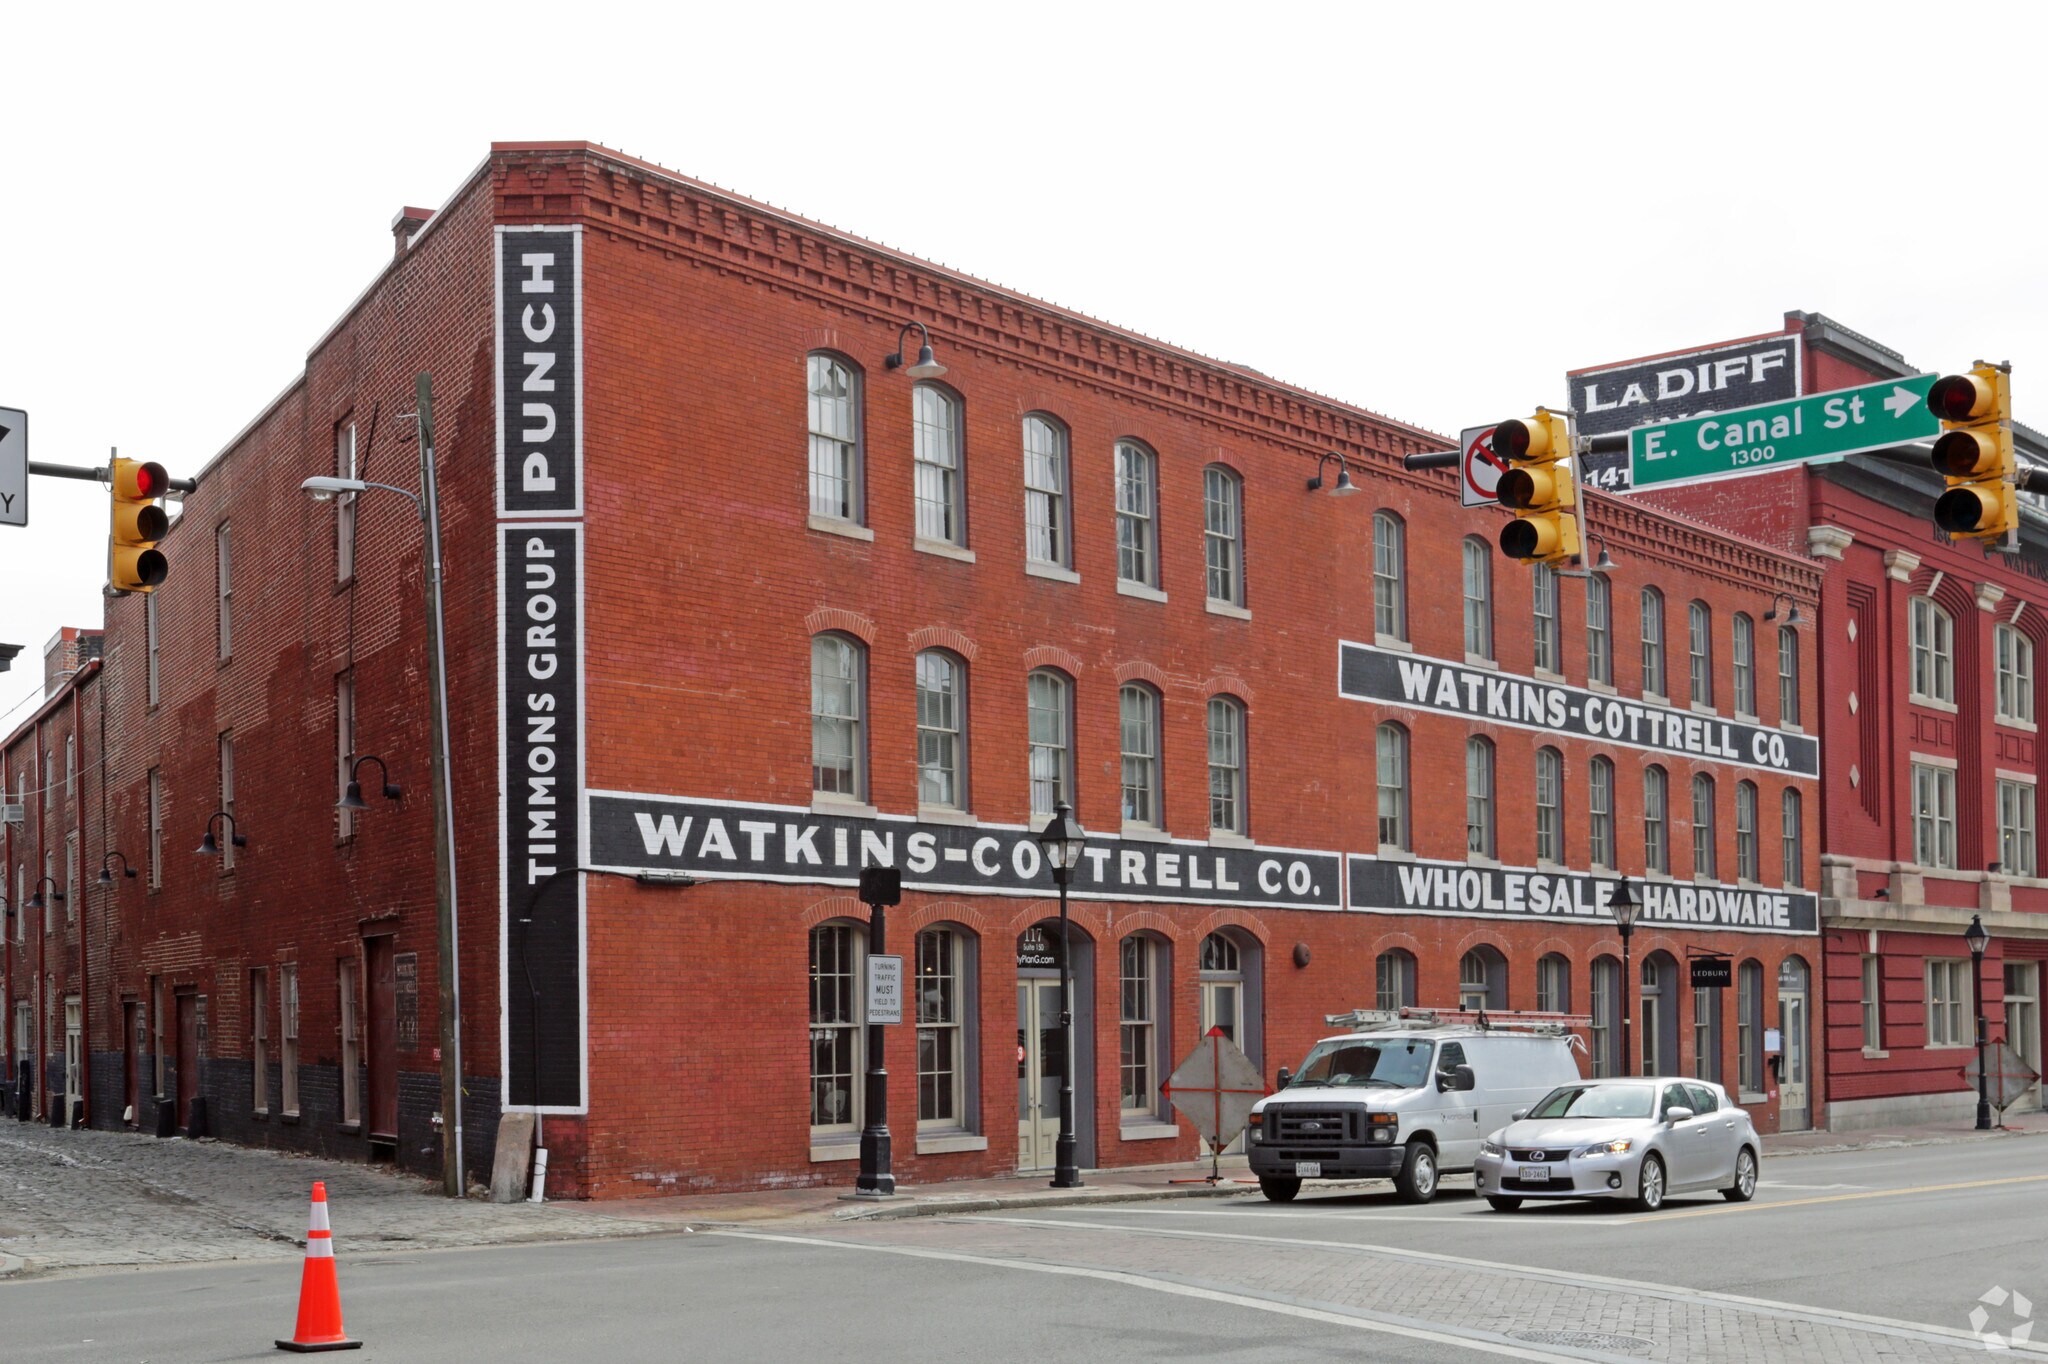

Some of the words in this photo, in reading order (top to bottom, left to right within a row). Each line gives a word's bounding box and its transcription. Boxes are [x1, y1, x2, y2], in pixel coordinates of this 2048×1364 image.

[521, 252, 557, 491] PUNCH
[1645, 430, 1678, 461] E.
[1697, 406, 1801, 450] Canal
[1824, 395, 1865, 429] St
[1730, 445, 1775, 465] 1300
[526, 536, 558, 680] GROUP
[1398, 660, 1739, 760] WATKINS-COTTRELL
[1752, 731, 1790, 767] CO.
[527, 693, 557, 884] TIMMONS
[1258, 859, 1321, 897] CO.
[1398, 865, 1616, 917] WHOLESALE
[1643, 885, 1791, 928] HARDWARE
[1025, 928, 1042, 942] 117
[1023, 943, 1035, 951] Suite
[874, 963, 896, 971] TURNING
[874, 974, 896, 982] TRAFFIC
[876, 985, 894, 995] MUST
[873, 998, 888, 1006] YIELD
[869, 1009, 900, 1017] PEDESTRIANS
